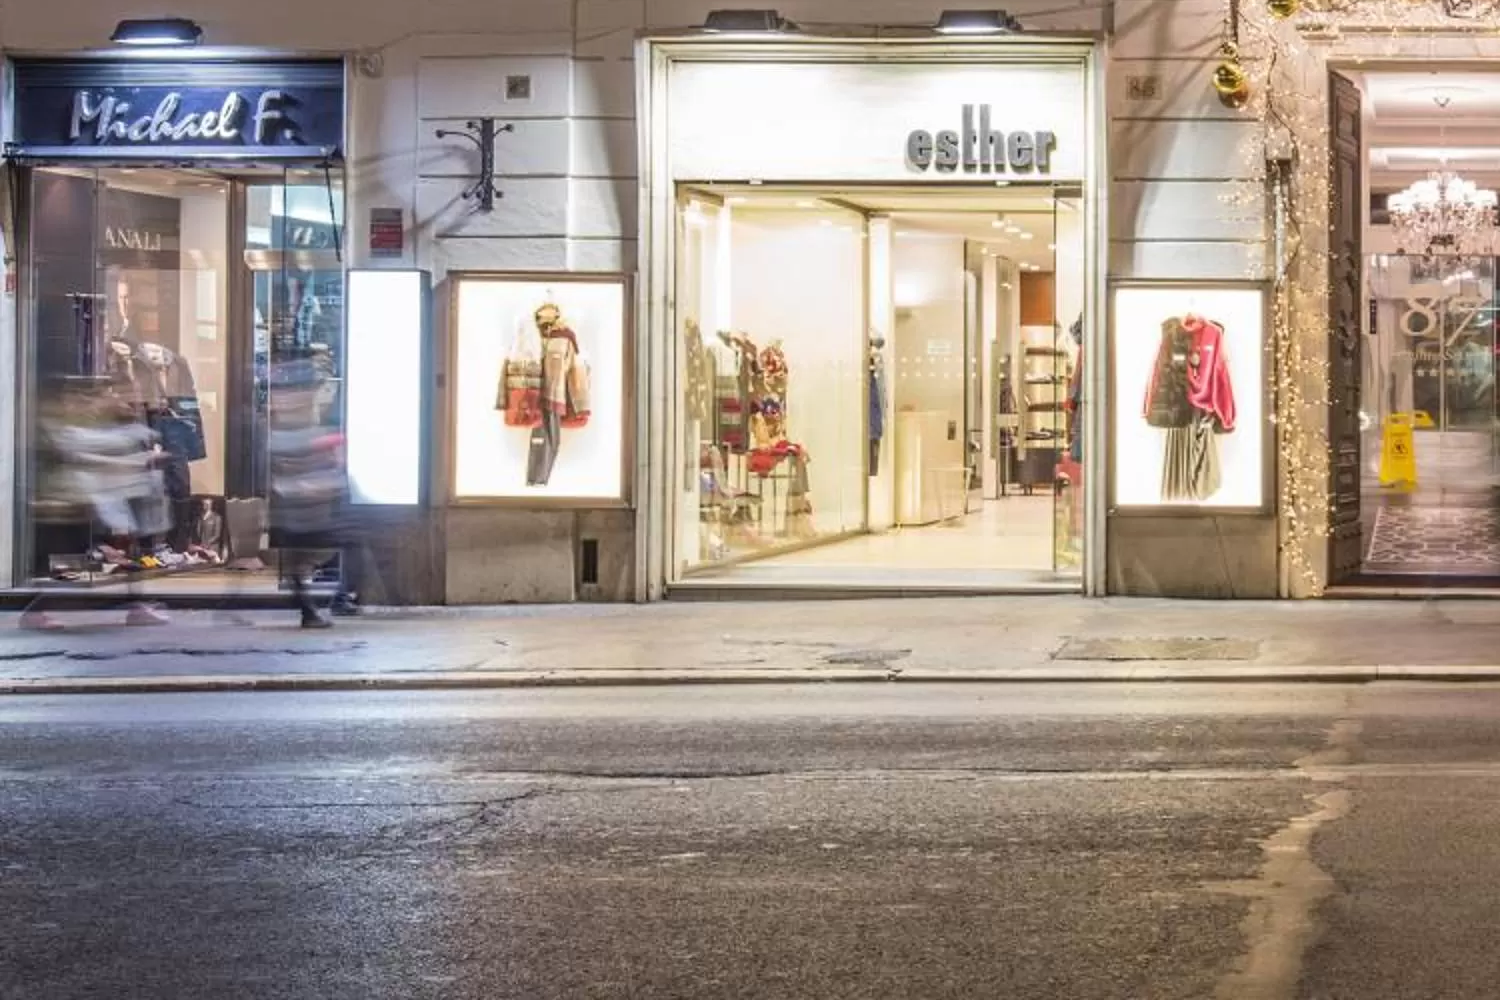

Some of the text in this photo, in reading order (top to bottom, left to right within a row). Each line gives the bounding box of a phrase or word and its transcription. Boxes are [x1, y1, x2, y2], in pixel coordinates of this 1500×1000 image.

[70, 88, 239, 143] Michael
[906, 103, 1057, 174] esther
[1400, 287, 1489, 347] 87
